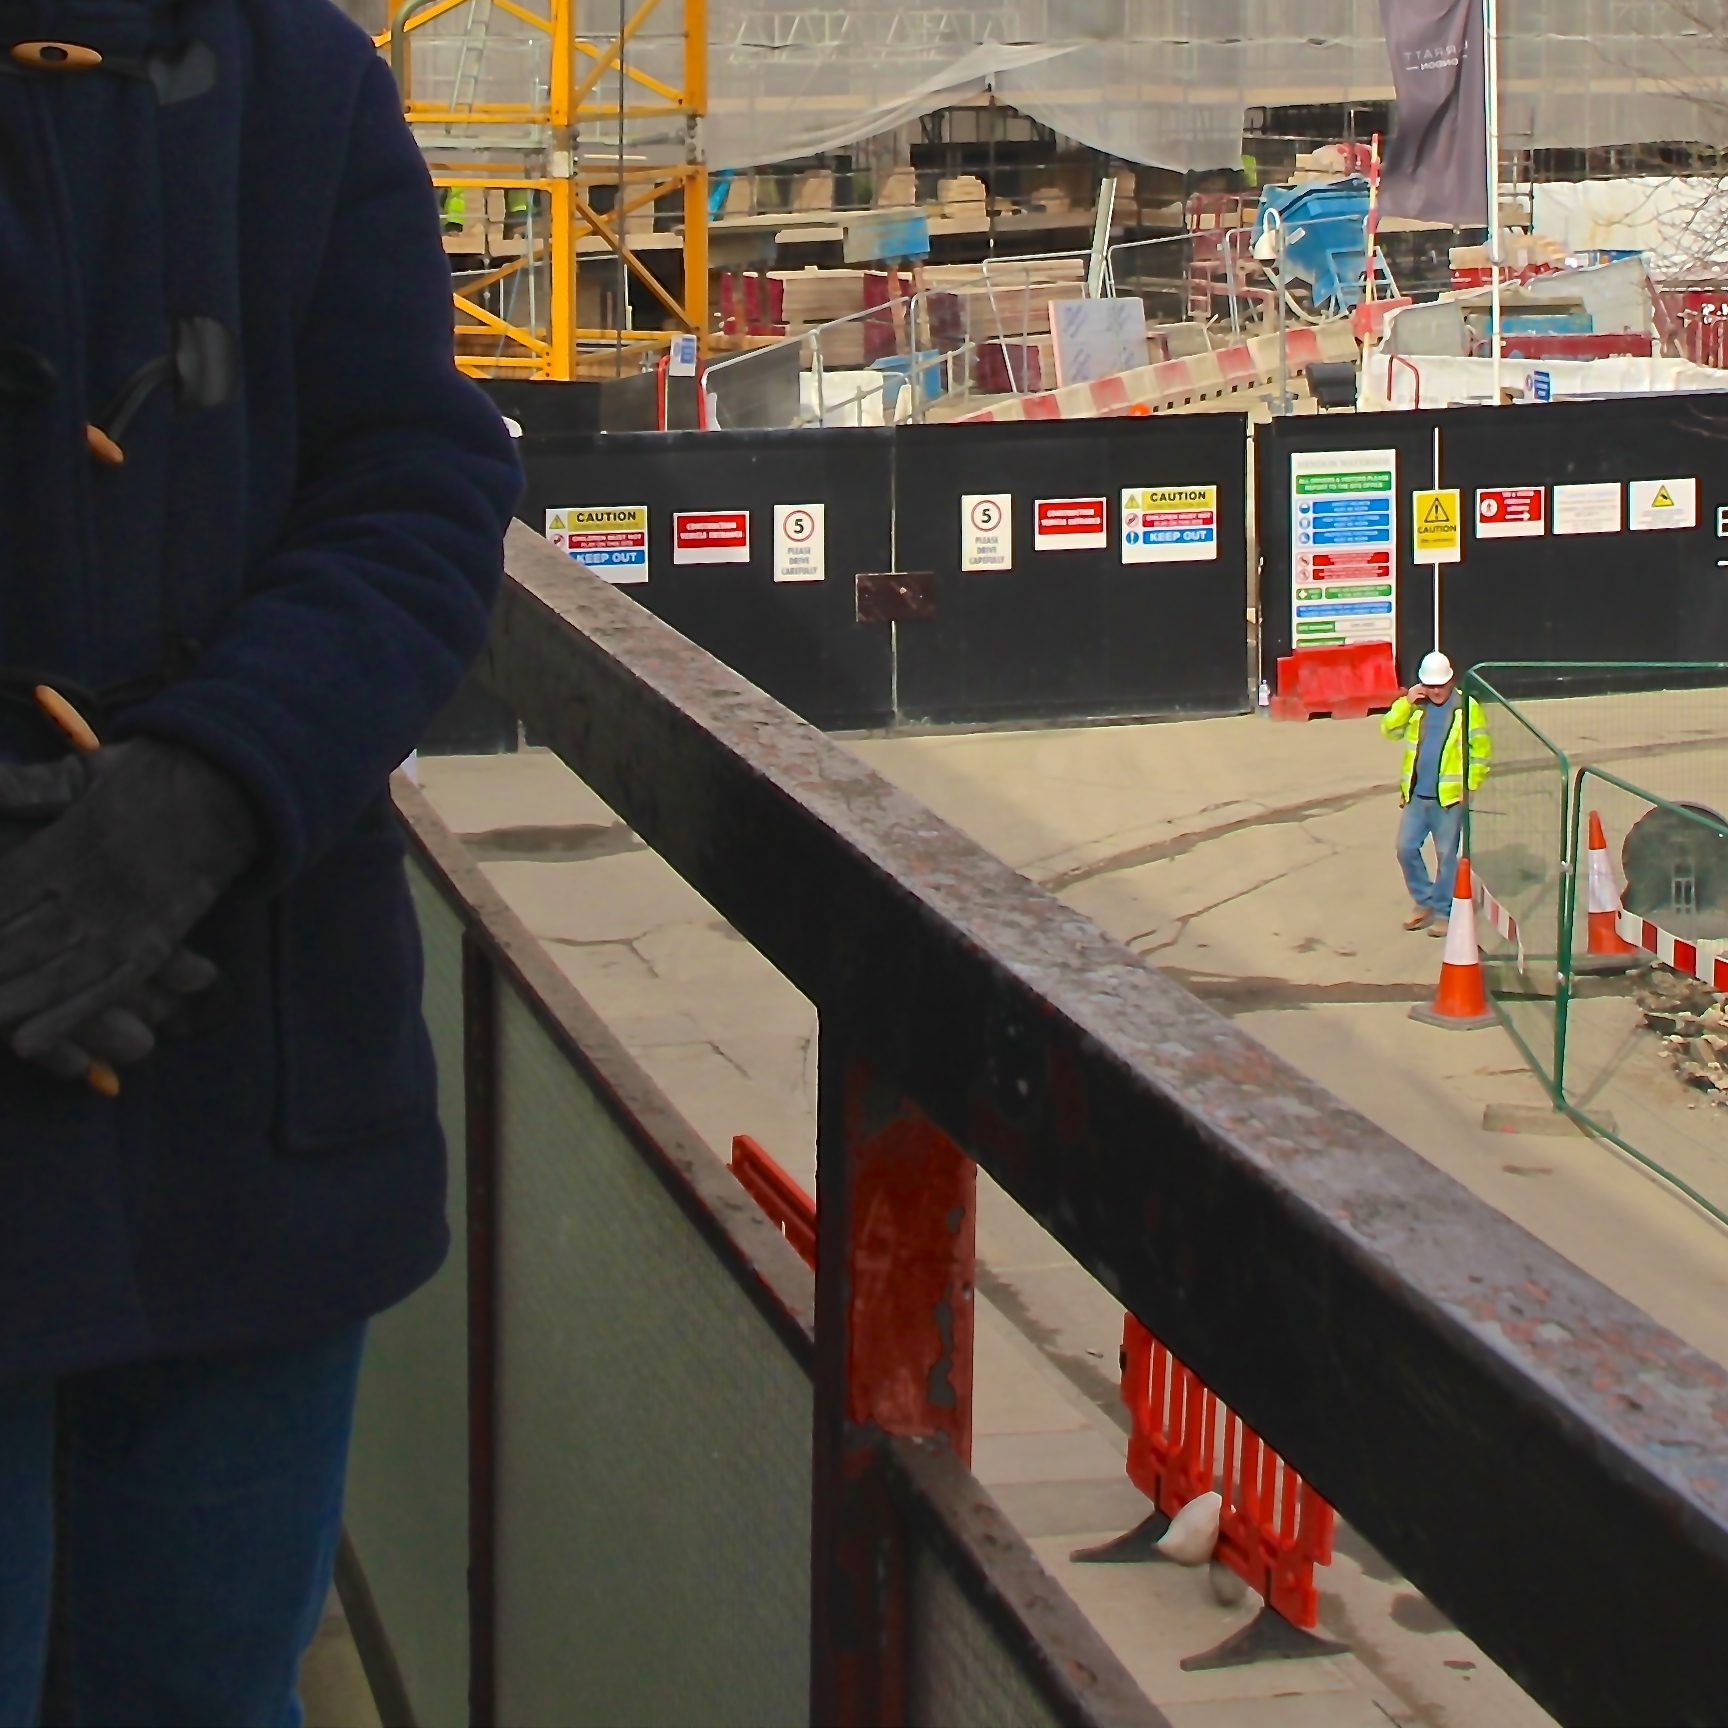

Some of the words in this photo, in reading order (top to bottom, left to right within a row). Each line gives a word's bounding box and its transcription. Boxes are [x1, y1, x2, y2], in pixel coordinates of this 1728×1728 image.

[1149, 491, 1206, 503] CAUTION
[576, 511, 637, 523] CAUTION
[980, 508, 992, 524] 5
[793, 518, 804, 534] 5
[1417, 525, 1457, 534] CAUTION
[1149, 531, 1181, 542] KEEP
[1182, 530, 1207, 541] OUT
[576, 553, 609, 564] KEEP
[612, 552, 637, 563] OUT
